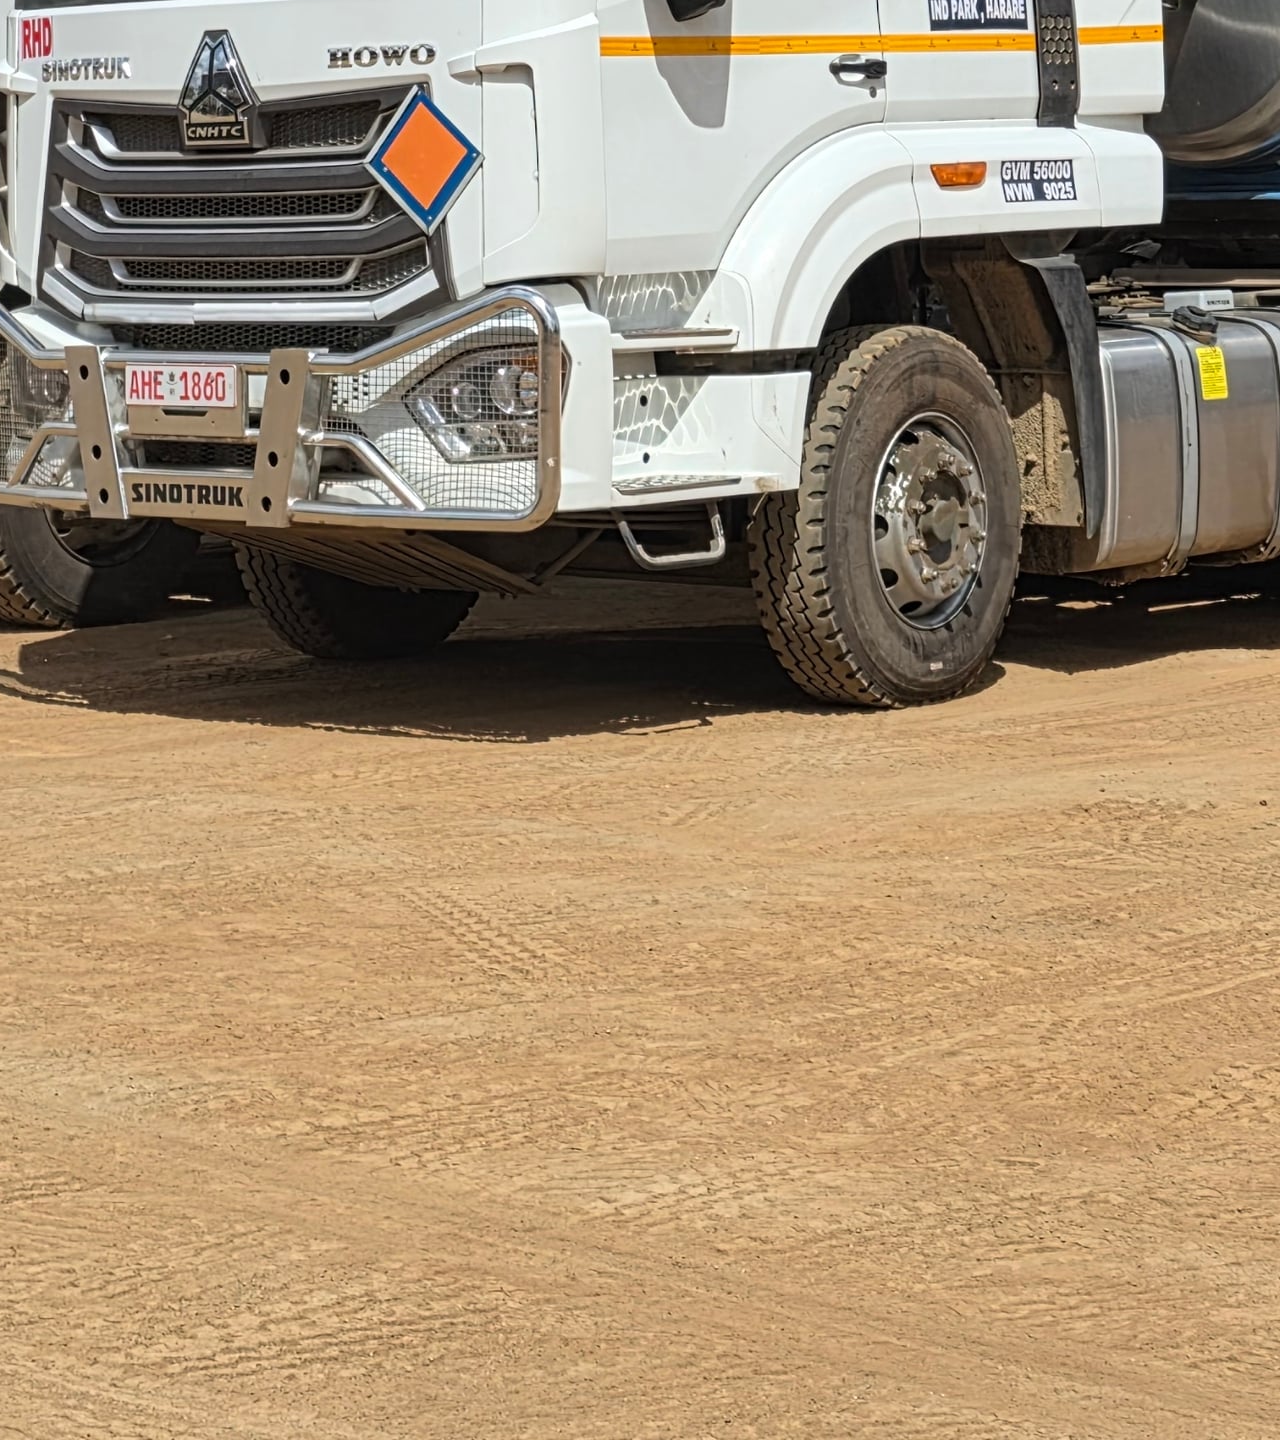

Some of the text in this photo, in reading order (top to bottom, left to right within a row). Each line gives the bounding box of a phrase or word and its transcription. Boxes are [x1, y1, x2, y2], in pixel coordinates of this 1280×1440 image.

[930, 0, 949, 20] IND
[951, 0, 979, 20] PARK
[986, 0, 1025, 19] HARARE
[23, 17, 52, 58] RHD
[328, 44, 435, 68] HOWO
[42, 57, 131, 82] SINOTRUK
[187, 125, 242, 137] CNHTC
[1002, 161, 1071, 180] GVM 56000
[1004, 182, 1074, 201] NVM 9025
[129, 370, 226, 402] AHE 1860
[131, 483, 244, 507] SINOTRUK
